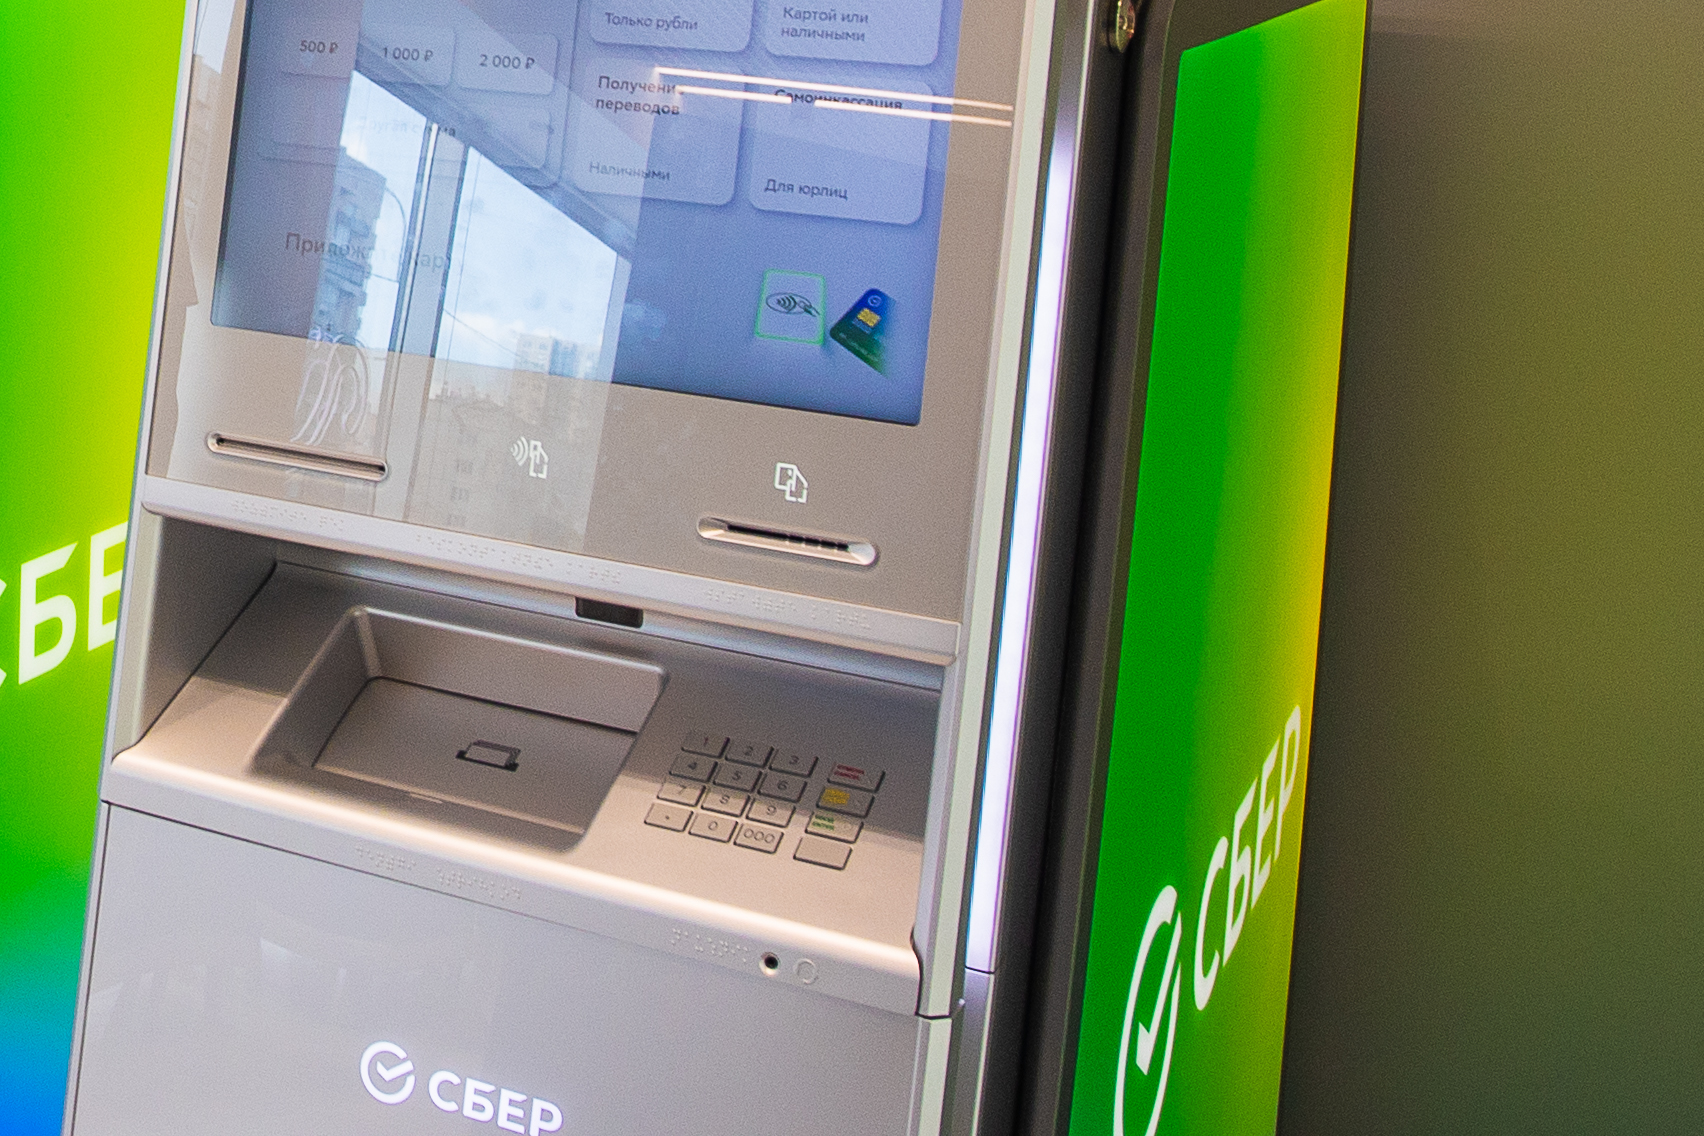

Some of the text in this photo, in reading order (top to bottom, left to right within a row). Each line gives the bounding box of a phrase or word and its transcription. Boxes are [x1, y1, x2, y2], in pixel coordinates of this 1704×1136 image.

[605, 11, 698, 32] Только рубли
[783, 6, 869, 24] Картой или
[781, 26, 866, 42] наличными
[299, 39, 326, 54] 500
[382, 46, 388, 59] 1
[392, 46, 420, 61] 000
[479, 53, 488, 67] 2
[492, 55, 522, 70] 000
[598, 76, 682, 95] Получени
[596, 98, 681, 116] переводов
[589, 162, 671, 182] Наличными
[764, 178, 849, 200] Для юрлиц
[743, 827, 776, 844] 000
[1193, 704, 1301, 1012] СБЕР
[428, 1069, 564, 1136] СБЕР
